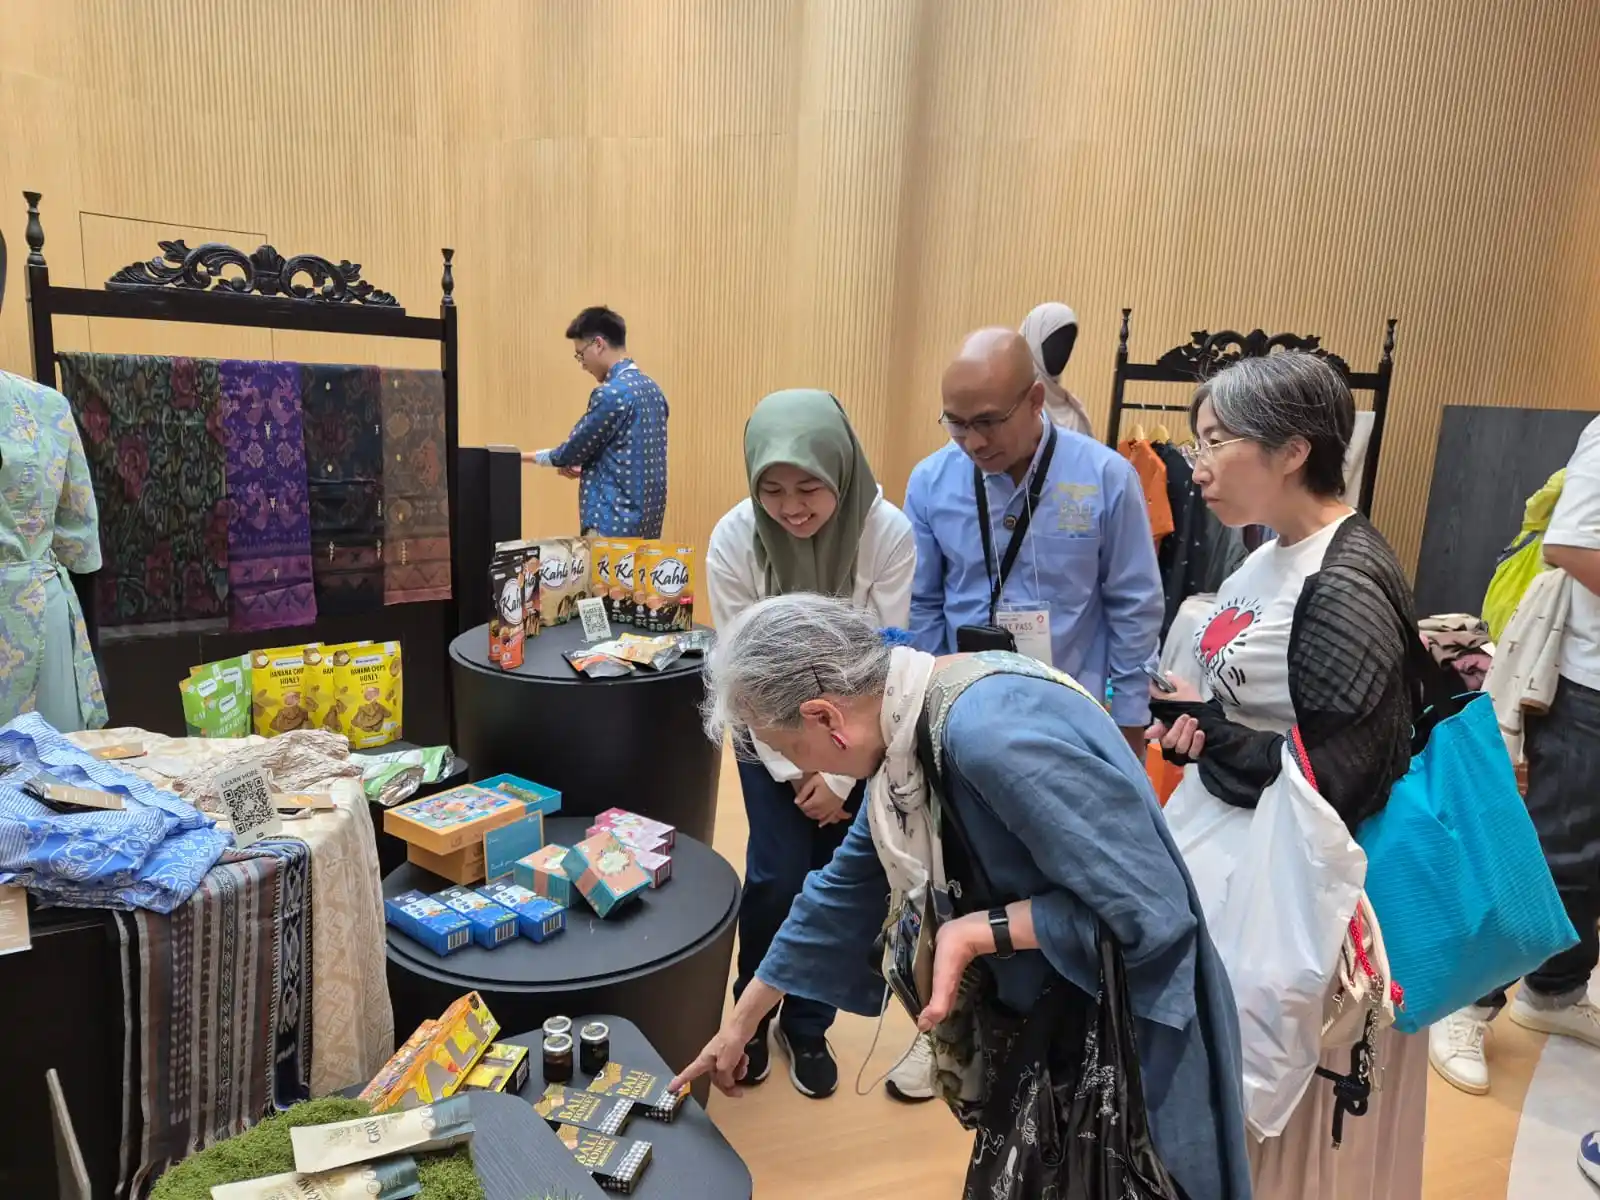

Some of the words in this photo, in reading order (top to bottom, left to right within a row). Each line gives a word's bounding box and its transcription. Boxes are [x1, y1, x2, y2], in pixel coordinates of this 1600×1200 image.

[649, 565, 689, 586] Kahla
[501, 588, 522, 613] Kah
[221, 776, 241, 788] LEARN
[242, 769, 259, 778] MORE
[558, 1092, 587, 1119] BALI
